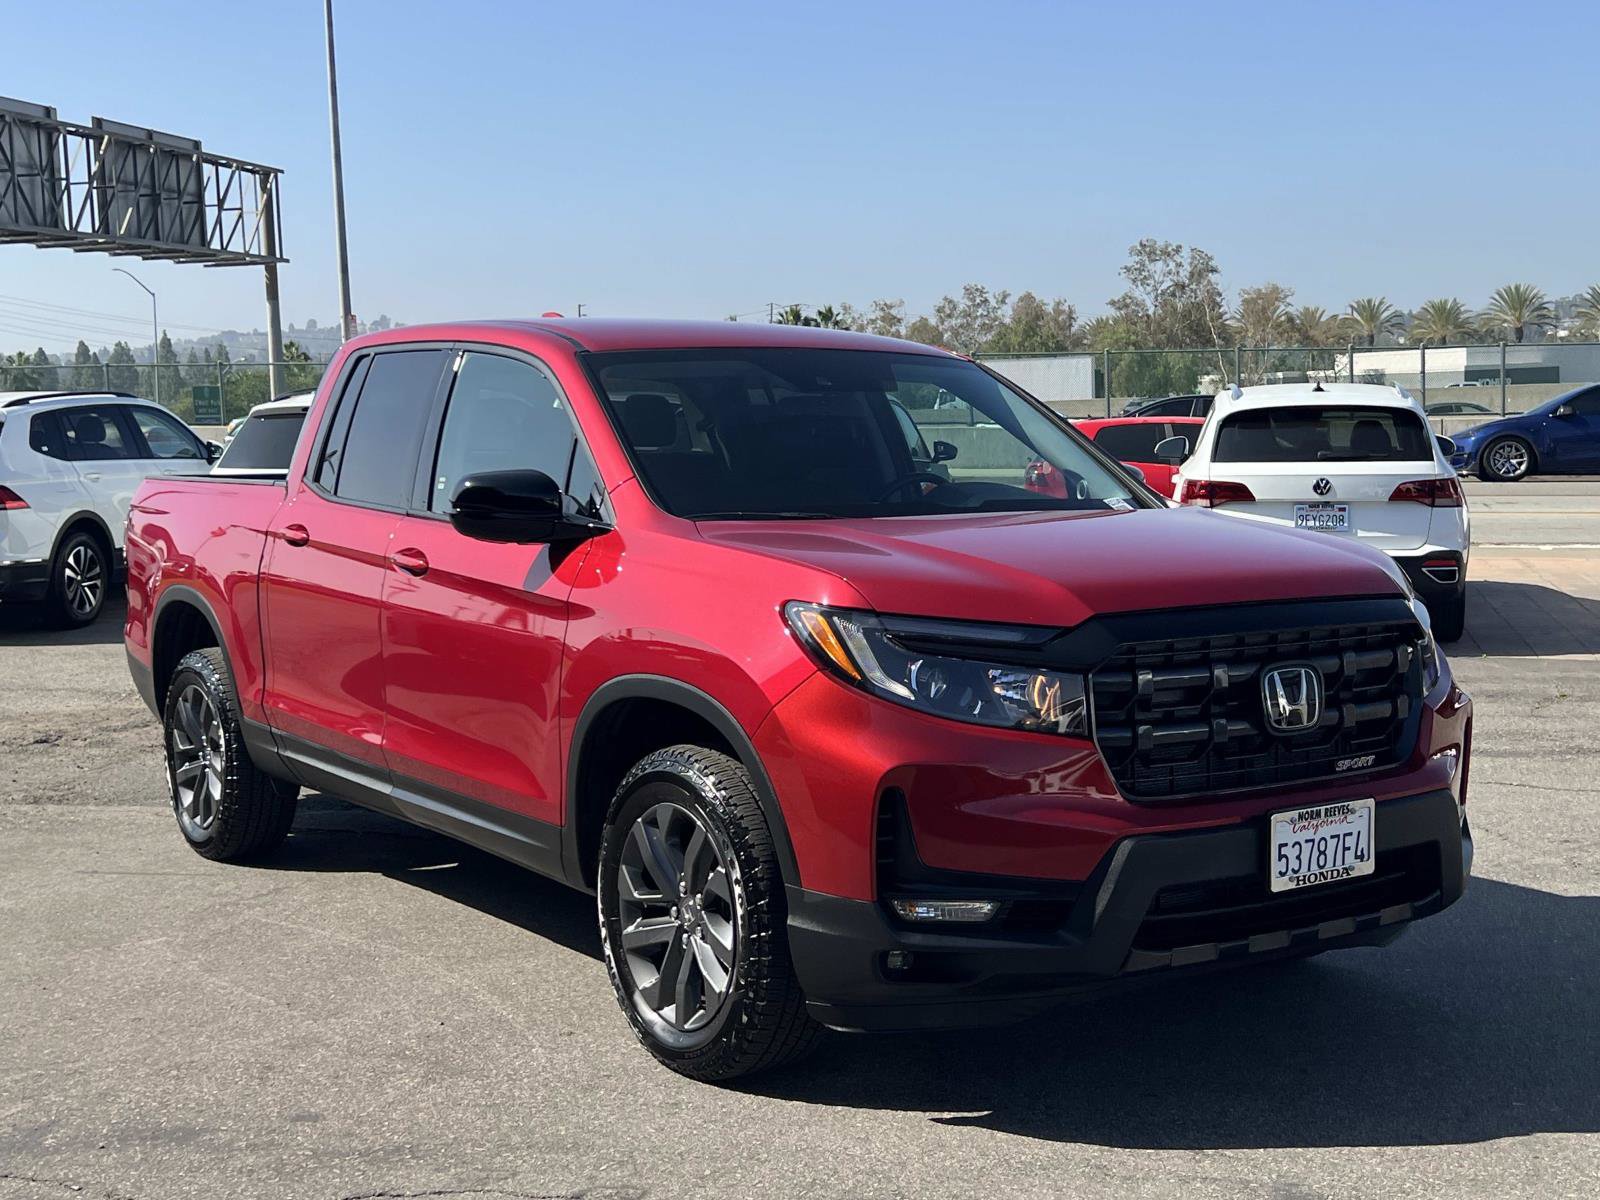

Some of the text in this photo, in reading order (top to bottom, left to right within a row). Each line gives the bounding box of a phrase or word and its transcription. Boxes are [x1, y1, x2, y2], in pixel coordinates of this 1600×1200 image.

[1298, 514, 1345, 527] 9FYG208
[1336, 755, 1376, 771] SPORT
[1297, 804, 1350, 822] NORM REEVES
[1277, 830, 1365, 878] 53787F4
[1295, 866, 1352, 887] HONDA
